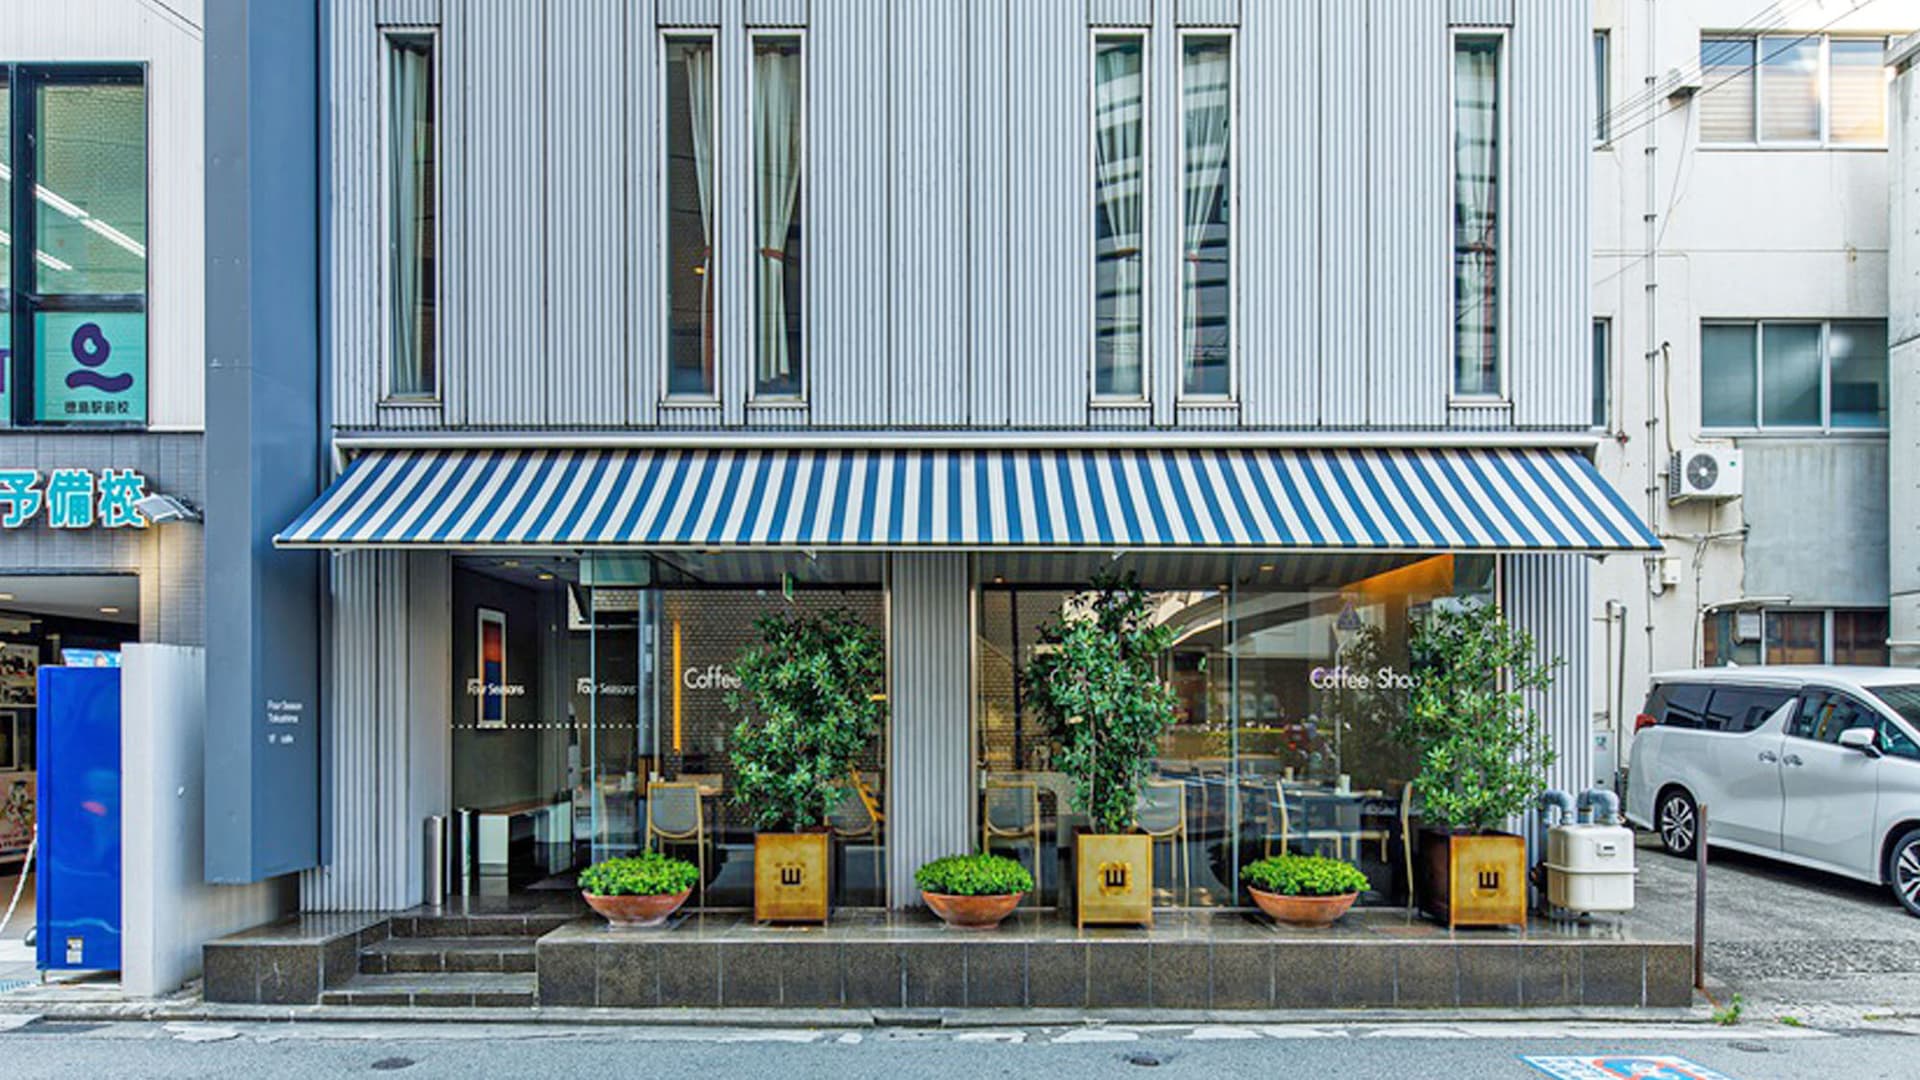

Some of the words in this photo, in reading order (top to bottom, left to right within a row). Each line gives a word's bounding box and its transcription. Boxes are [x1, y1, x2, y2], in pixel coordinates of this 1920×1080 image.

[0, 468, 146, 528] 予備校
[684, 665, 742, 689] Coffee
[1310, 665, 1369, 689] Coffee
[488, 683, 525, 696] Seasons
